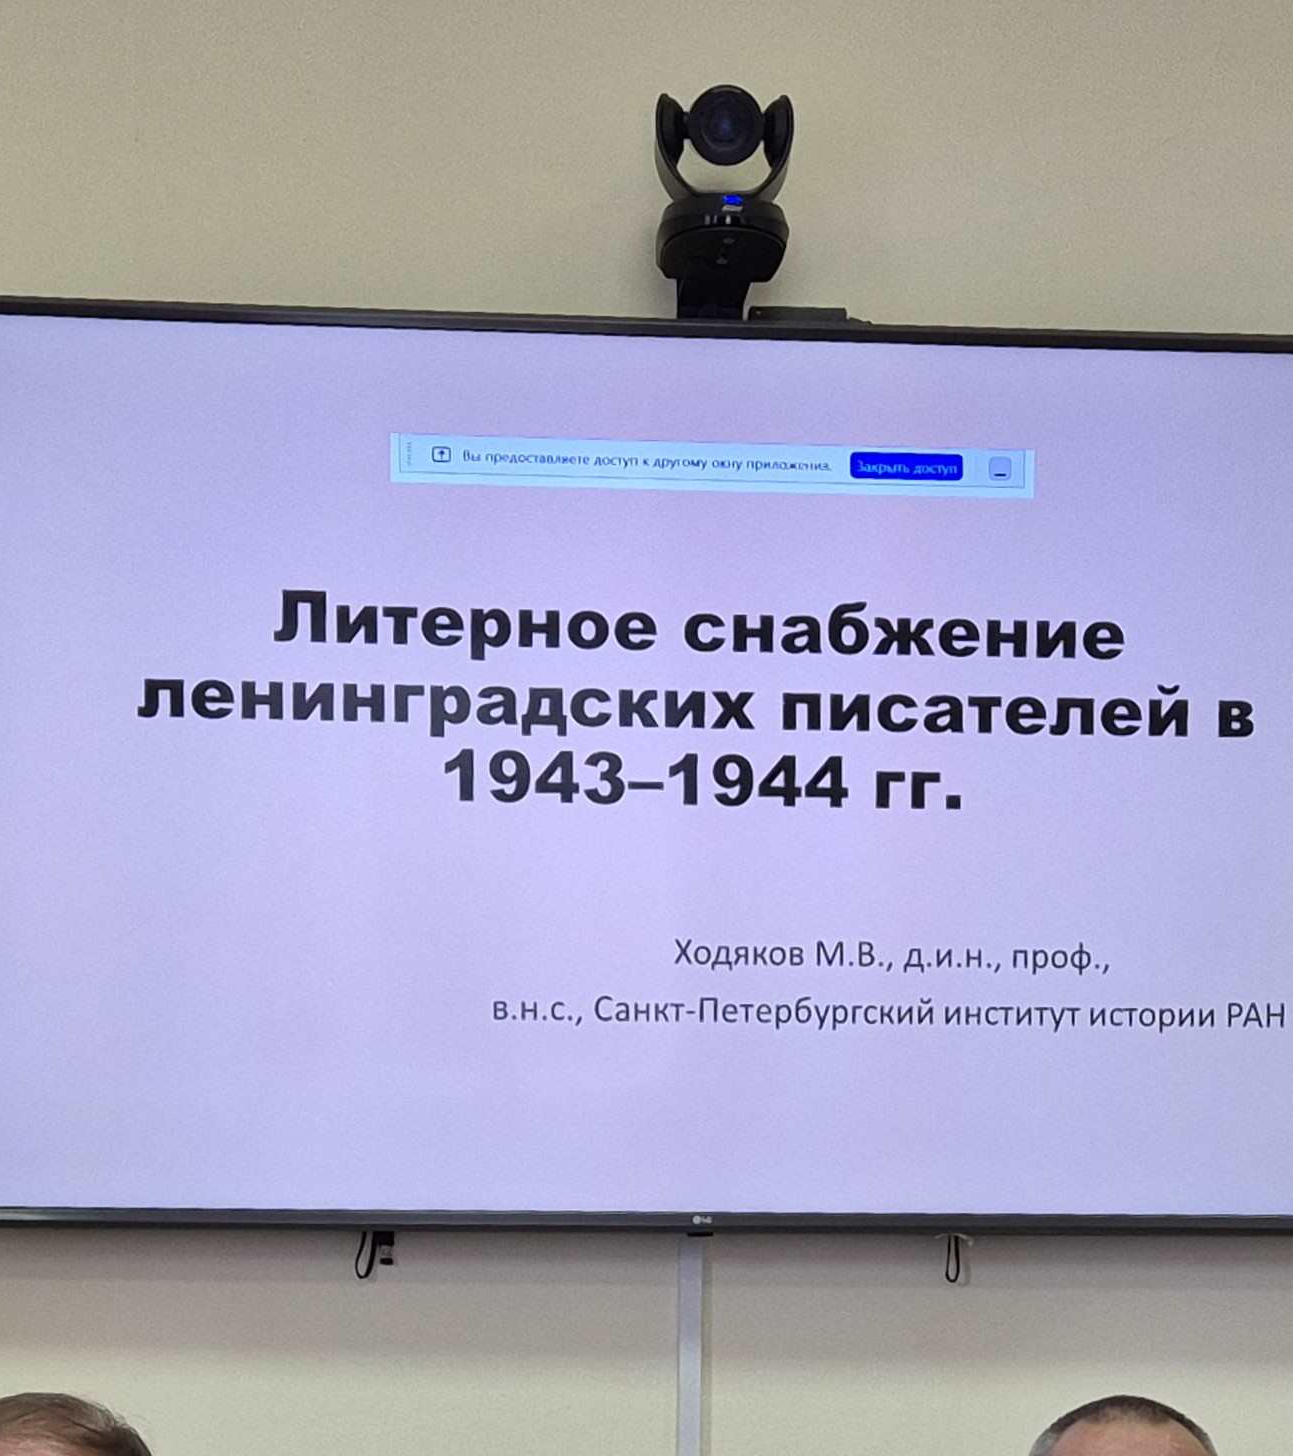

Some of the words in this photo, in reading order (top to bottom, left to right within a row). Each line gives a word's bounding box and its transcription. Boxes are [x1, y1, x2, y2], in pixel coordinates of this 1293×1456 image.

[462, 448, 482, 461] Вы
[484, 452, 591, 466] предоставляете
[593, 455, 639, 470] доступ
[642, 457, 651, 467] к
[652, 457, 708, 471] другому
[711, 459, 743, 472] окну
[857, 458, 910, 474] Закрыть
[913, 461, 959, 476] доступ
[273, 589, 658, 660] Литерное
[682, 600, 1126, 660] снабжение
[137, 678, 756, 738] ленинградских
[781, 684, 1190, 738] писателей
[1217, 700, 1255, 738] в
[874, 766, 962, 810] гг.
[673, 938, 804, 970] Ходяков
[815, 940, 894, 972] М.В.,
[903, 948, 1002, 974] д.и.н.,
[1012, 942, 1111, 976] проф.,
[492, 1000, 583, 1026] в.н.с.,
[594, 995, 934, 1031] Санкт-Петербургский
[944, 1006, 1081, 1034] институт
[1089, 1007, 1216, 1034] истории
[1226, 1002, 1286, 1029] РАН
